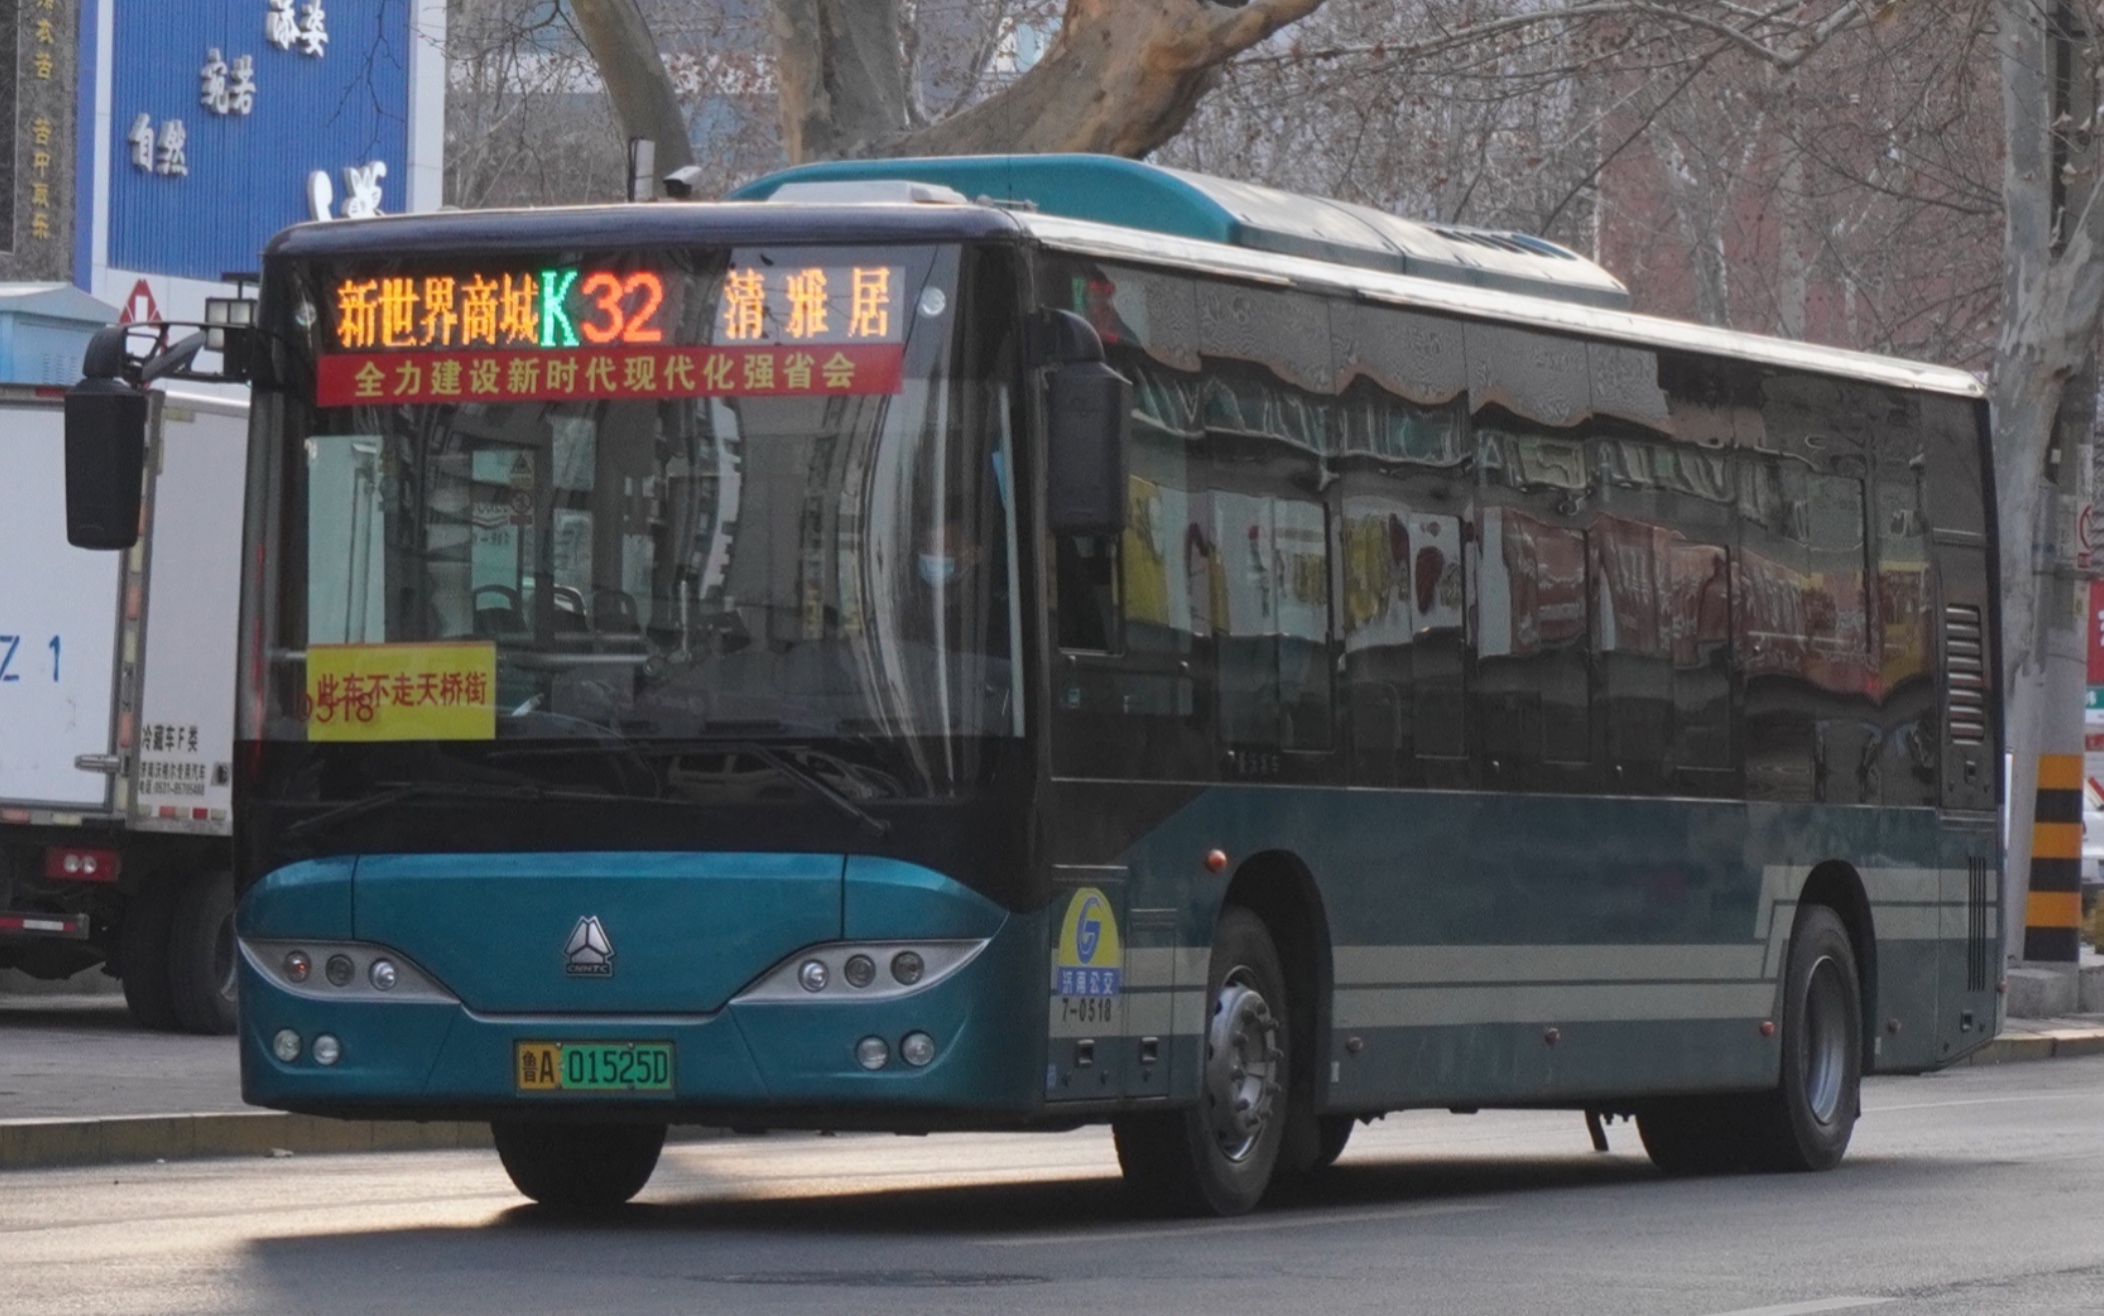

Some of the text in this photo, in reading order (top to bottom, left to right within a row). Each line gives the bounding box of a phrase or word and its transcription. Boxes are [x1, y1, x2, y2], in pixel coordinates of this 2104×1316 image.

[128, 112, 188, 176] 自然
[337, 267, 891, 348] 新世界商城 K32 清雅居
[354, 351, 857, 398] 全力建设新时代现代化强省会
[317, 671, 488, 707] 此车不走天桥街
[1062, 969, 1115, 995] 济南公交
[1062, 997, 1112, 1022] 7-0518
[568, 1051, 668, 1084] 01525D
